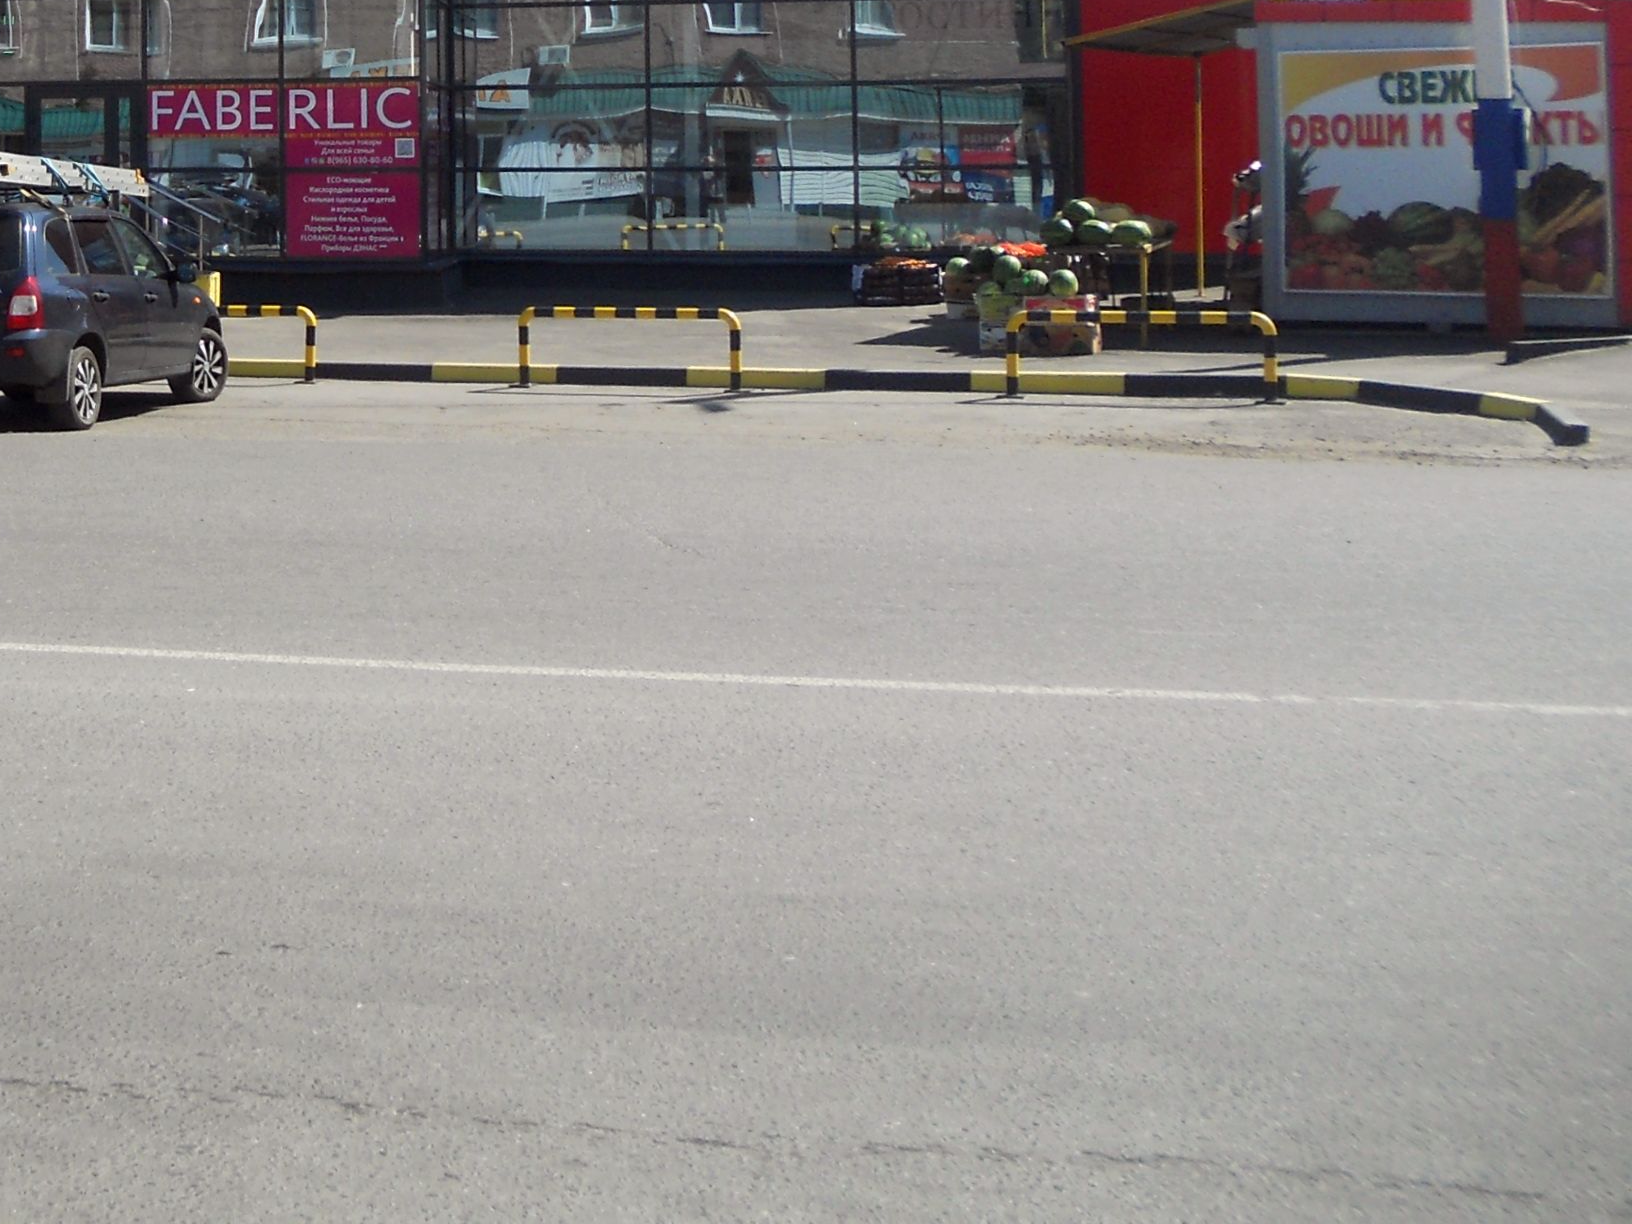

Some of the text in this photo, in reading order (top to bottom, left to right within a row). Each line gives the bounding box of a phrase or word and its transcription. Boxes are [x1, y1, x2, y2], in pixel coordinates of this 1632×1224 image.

[1378, 69, 1515, 104] СВЕЖ
[151, 88, 413, 131] FABERLIC
[1421, 113, 1444, 147] И
